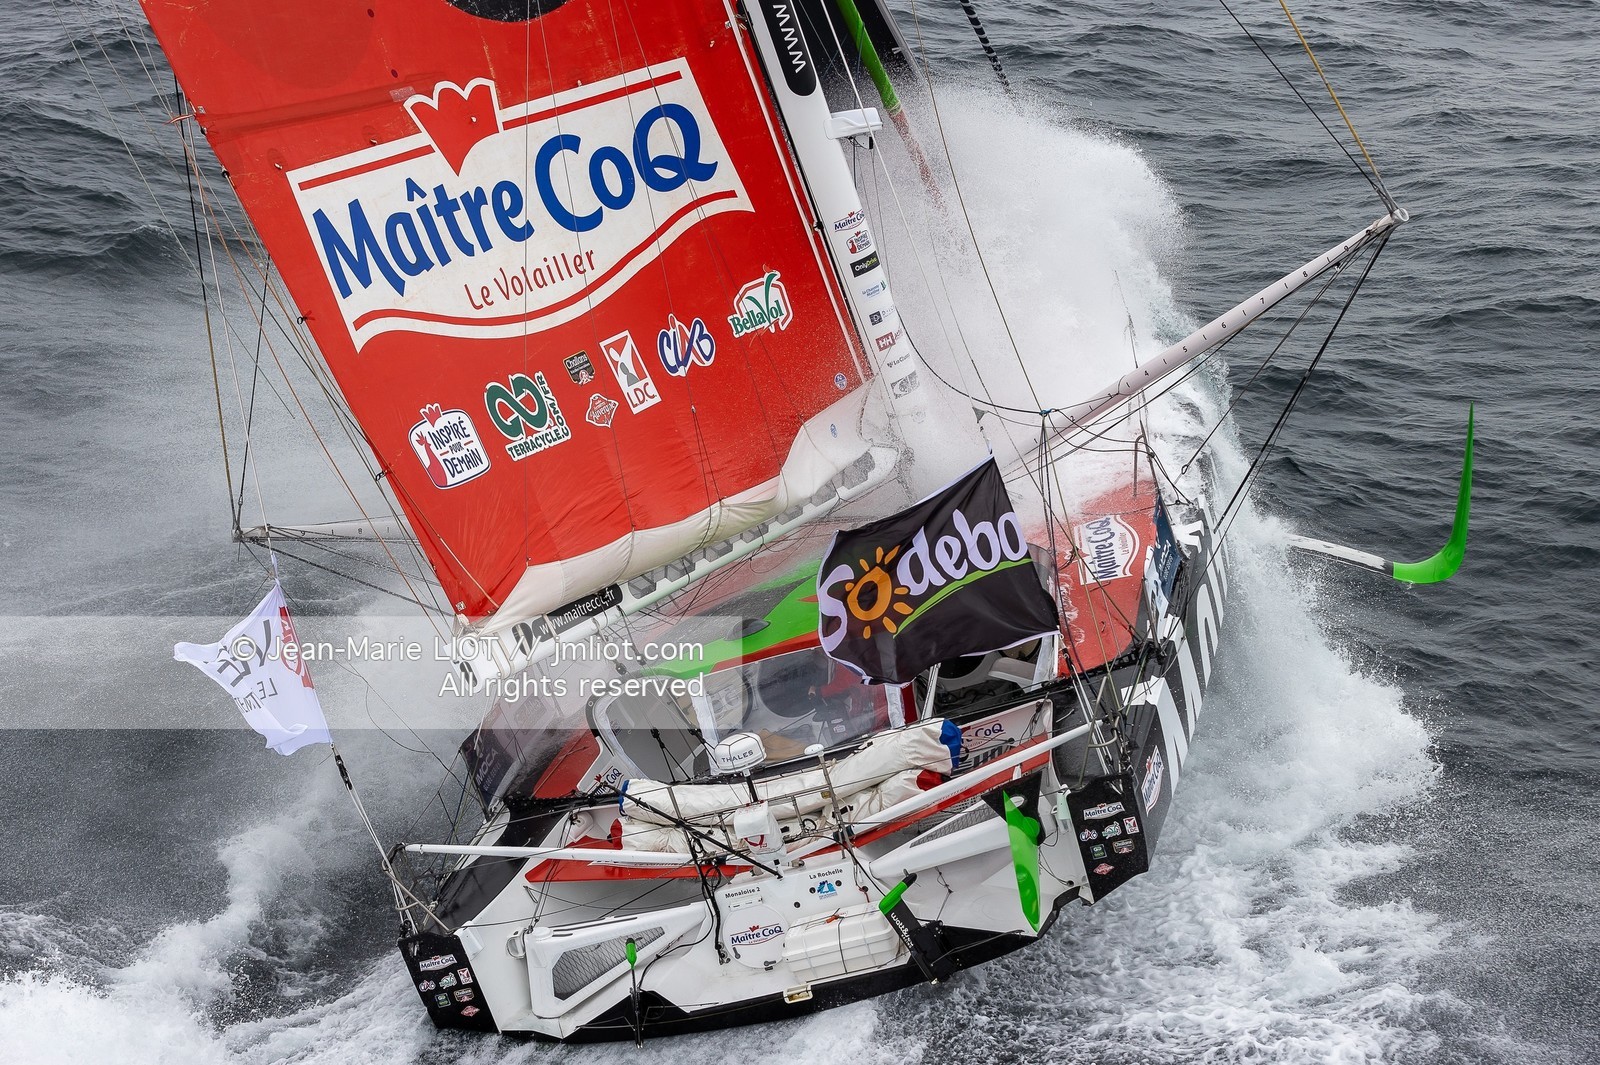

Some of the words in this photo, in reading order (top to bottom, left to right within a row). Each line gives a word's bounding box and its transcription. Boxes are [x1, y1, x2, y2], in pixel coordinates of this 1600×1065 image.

[312, 177, 535, 300] Maître
[535, 103, 719, 233] CoQ
[464, 283, 495, 310] Le
[497, 249, 596, 302] Volailler
[721, 749, 754, 763] THALES
[817, 868, 844, 878] Rochelle
[731, 931, 761, 945] Maître
[761, 925, 783, 938] CoQ
